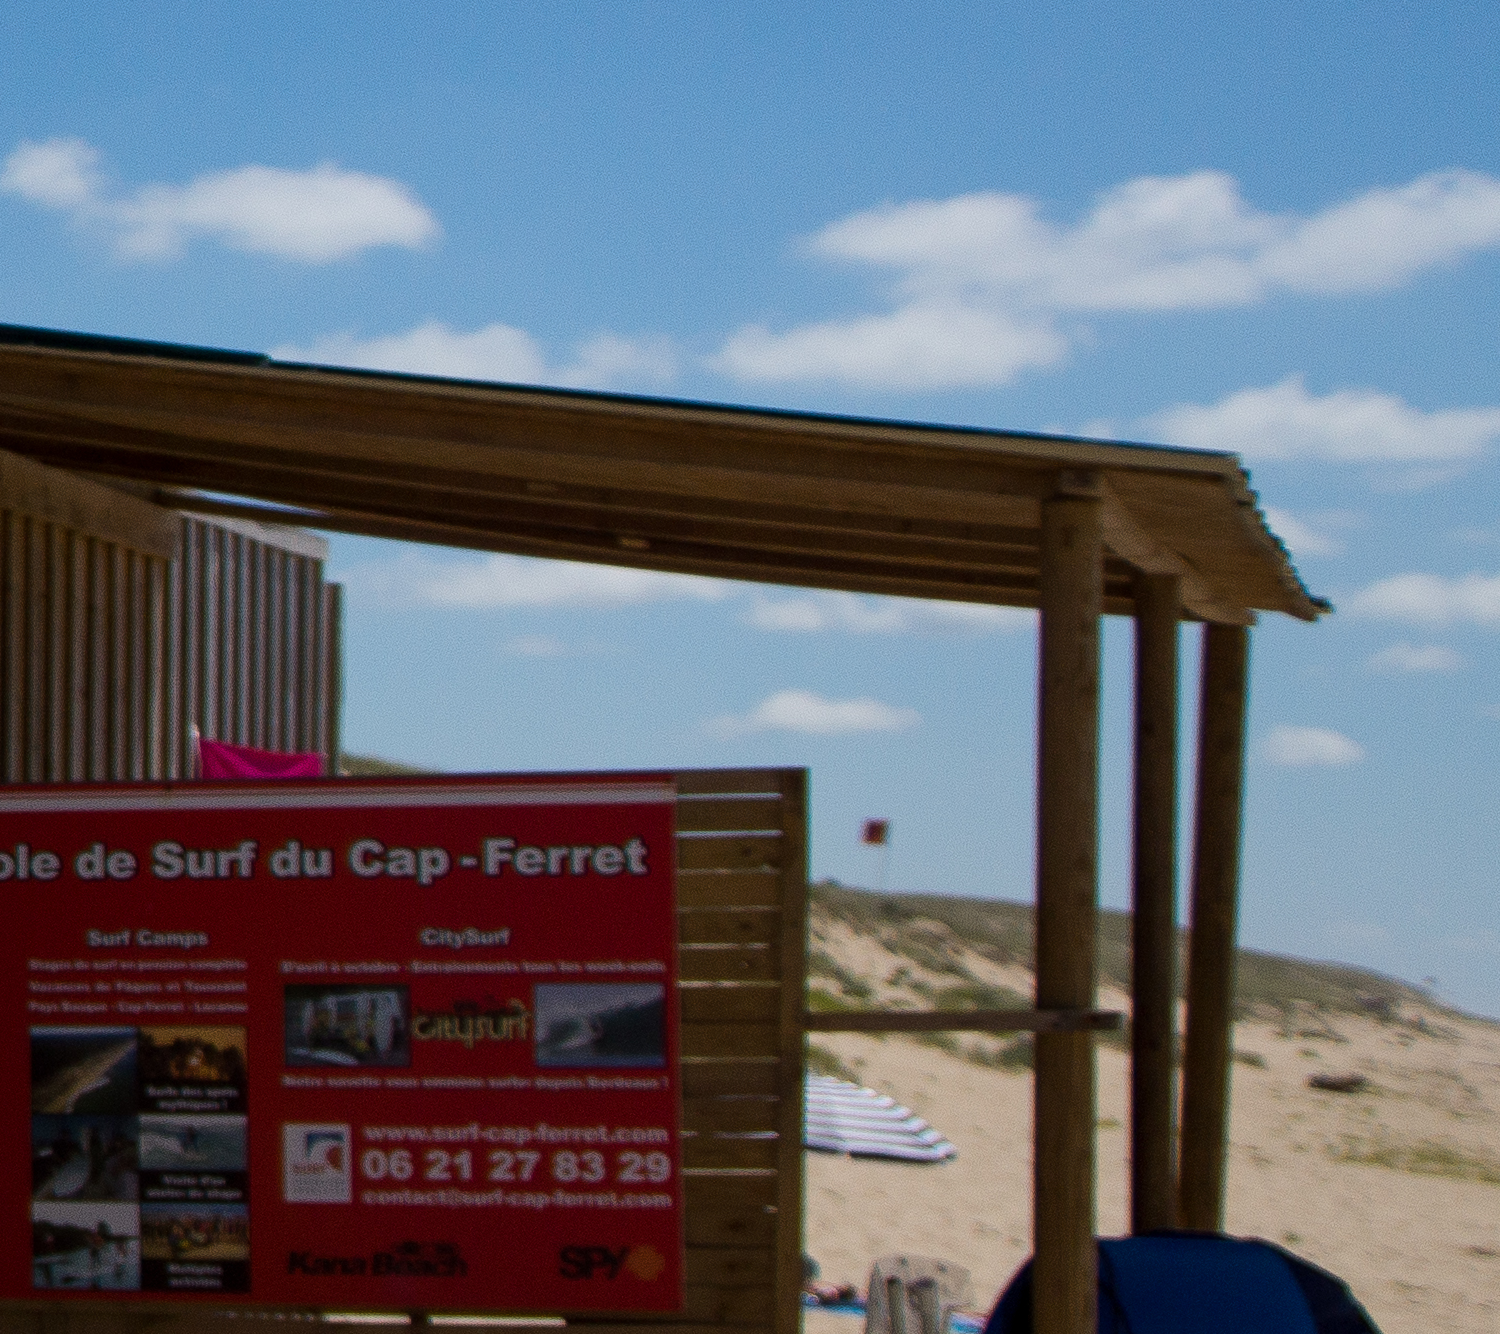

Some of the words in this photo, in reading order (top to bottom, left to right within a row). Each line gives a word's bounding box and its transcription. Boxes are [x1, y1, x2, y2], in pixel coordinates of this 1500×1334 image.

[73, 842, 138, 882] de
[152, 839, 258, 882] Surf
[270, 839, 336, 880] du
[87, 928, 132, 947] Surf
[135, 928, 209, 949] Camps
[419, 926, 511, 949] CitySurf
[362, 1122, 669, 1146] www.surf-cap-ferret.com
[360, 1148, 414, 1182] 06
[423, 1149, 474, 1182] 21
[488, 1149, 541, 1182] 27
[551, 1150, 606, 1183] 83
[616, 1150, 672, 1184] 29
[361, 1188, 673, 1211] contact@surf-cap-ferret.com
